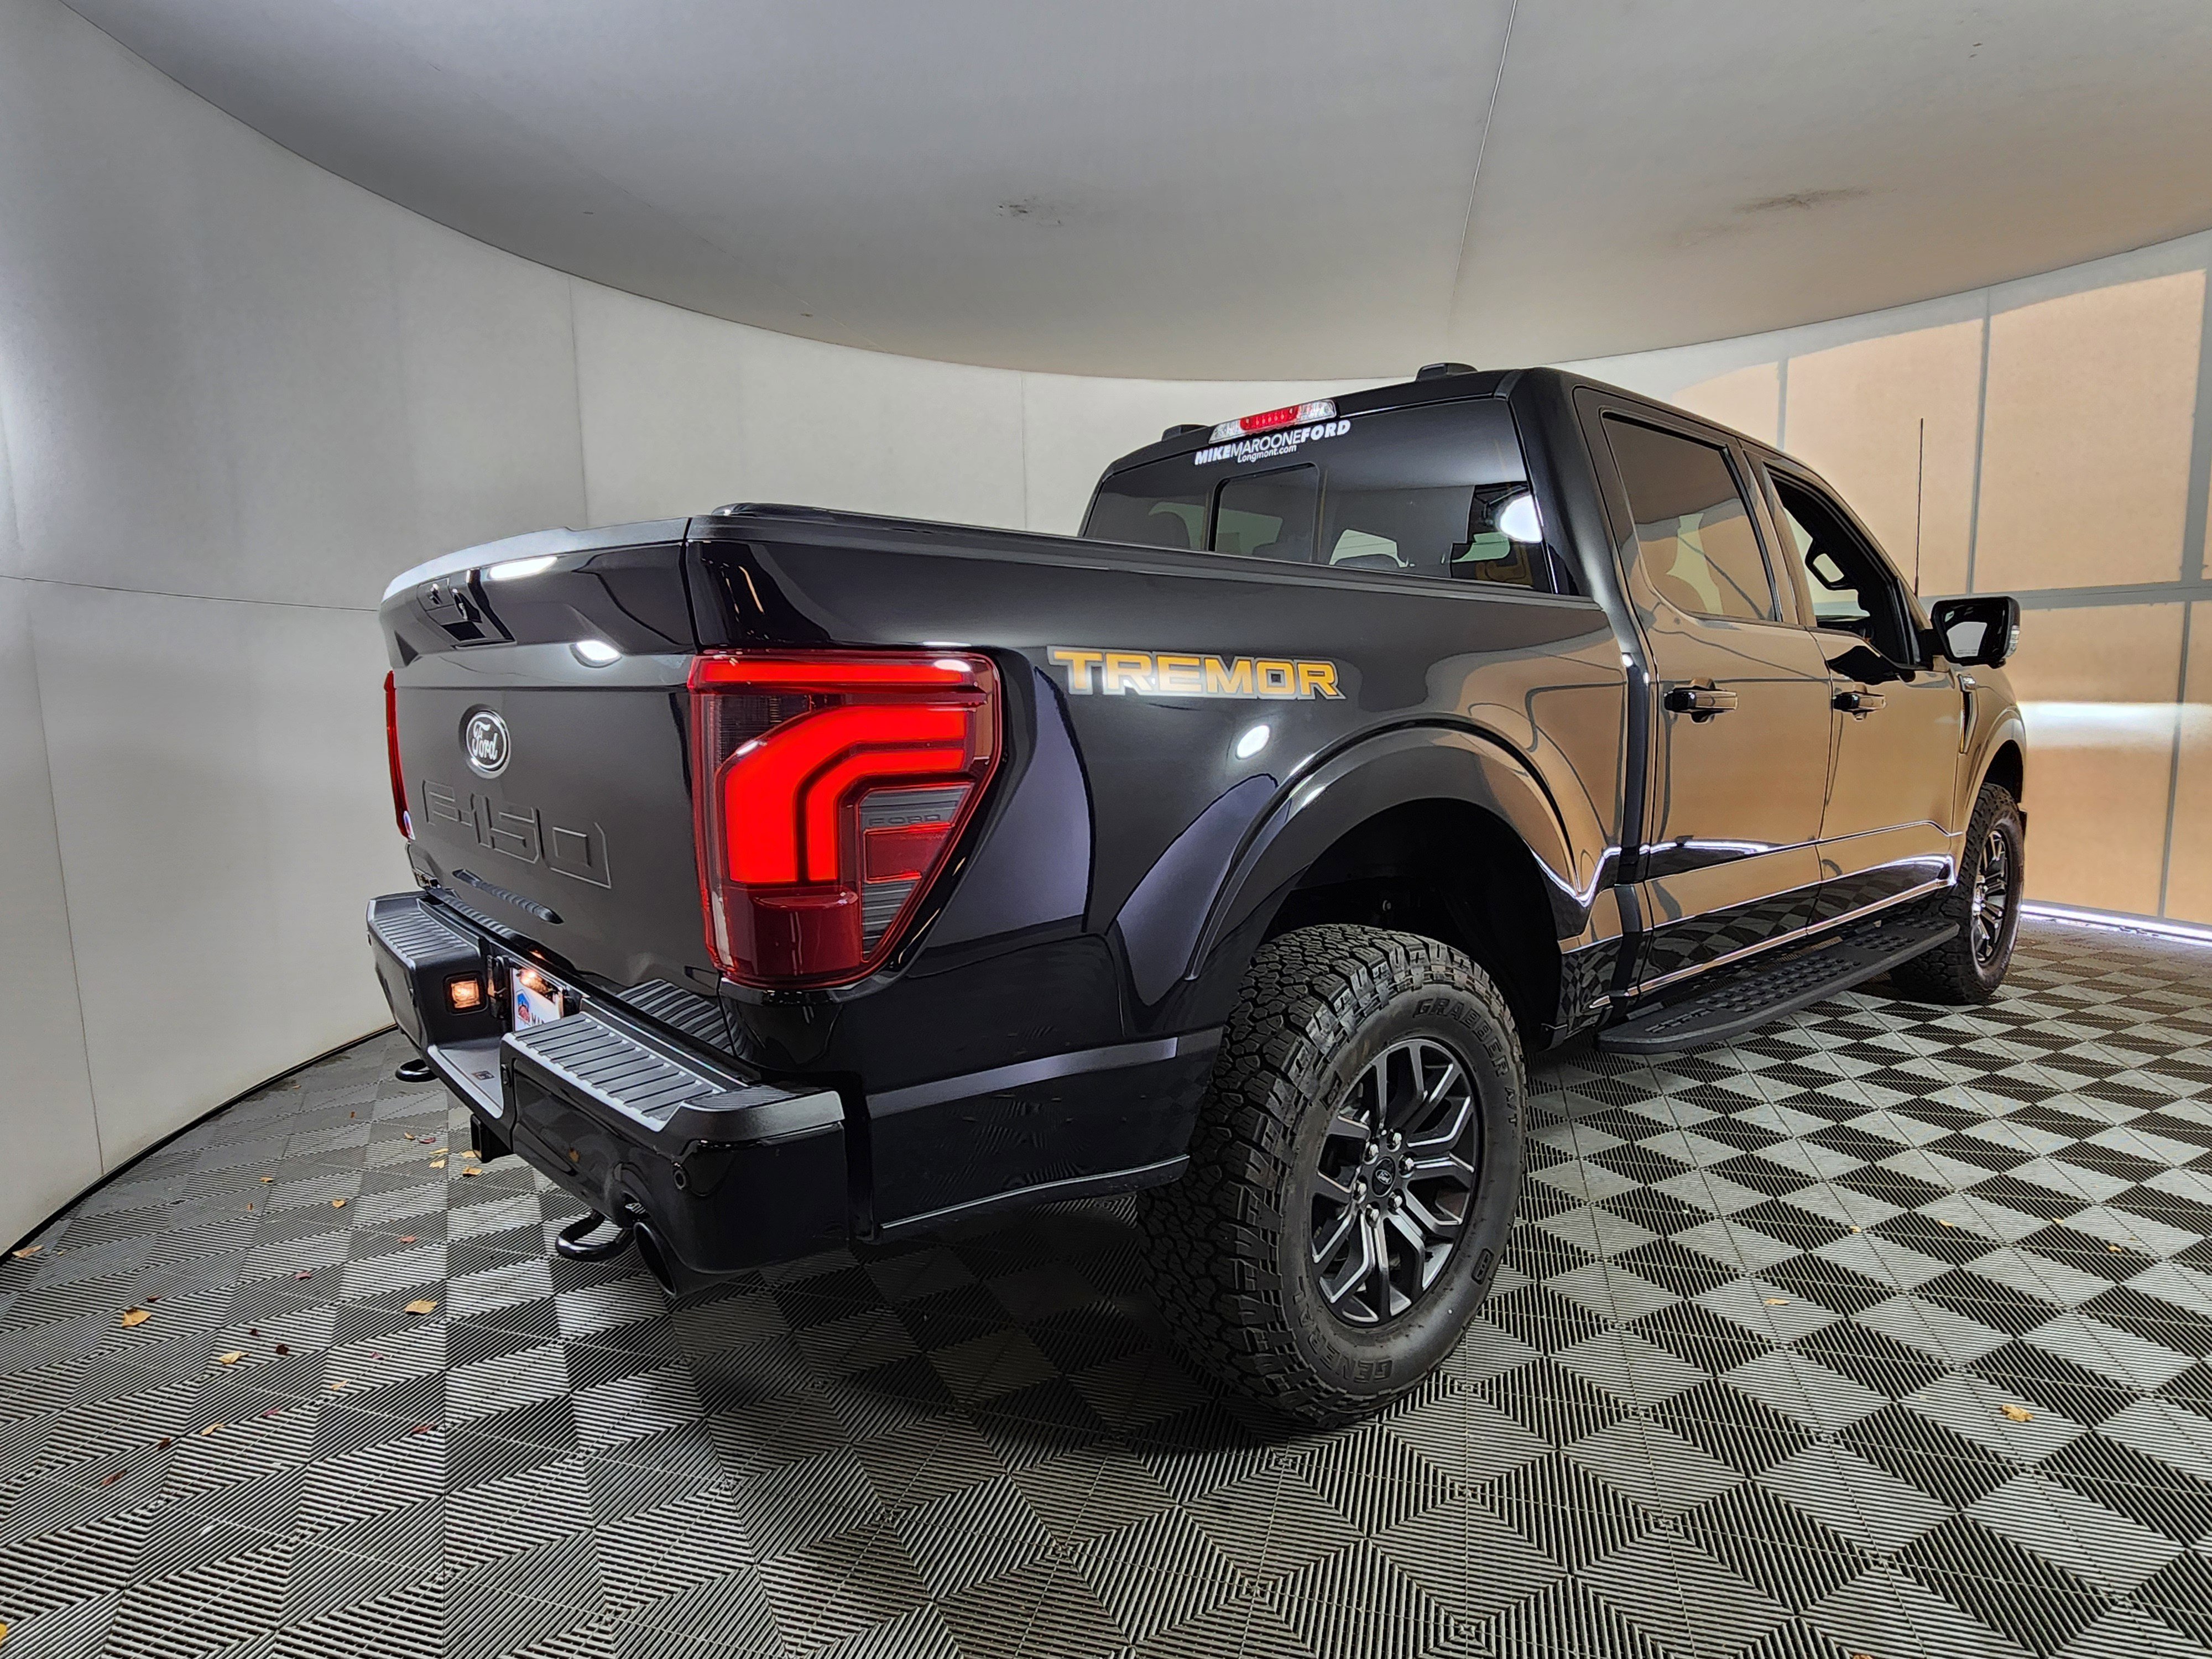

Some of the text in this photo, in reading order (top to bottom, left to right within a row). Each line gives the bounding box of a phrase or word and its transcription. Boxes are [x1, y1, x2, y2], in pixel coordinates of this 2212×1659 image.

[1237, 444, 1297, 463] Longmont.com
[1047, 645, 1346, 700] TREMOR
[471, 721, 498, 760] Ford
[422, 779, 611, 889] F-150
[868, 814, 941, 826] FORD
[1412, 997, 1510, 1077] GRABBER
[1292, 1276, 1393, 1384] GENERAL
